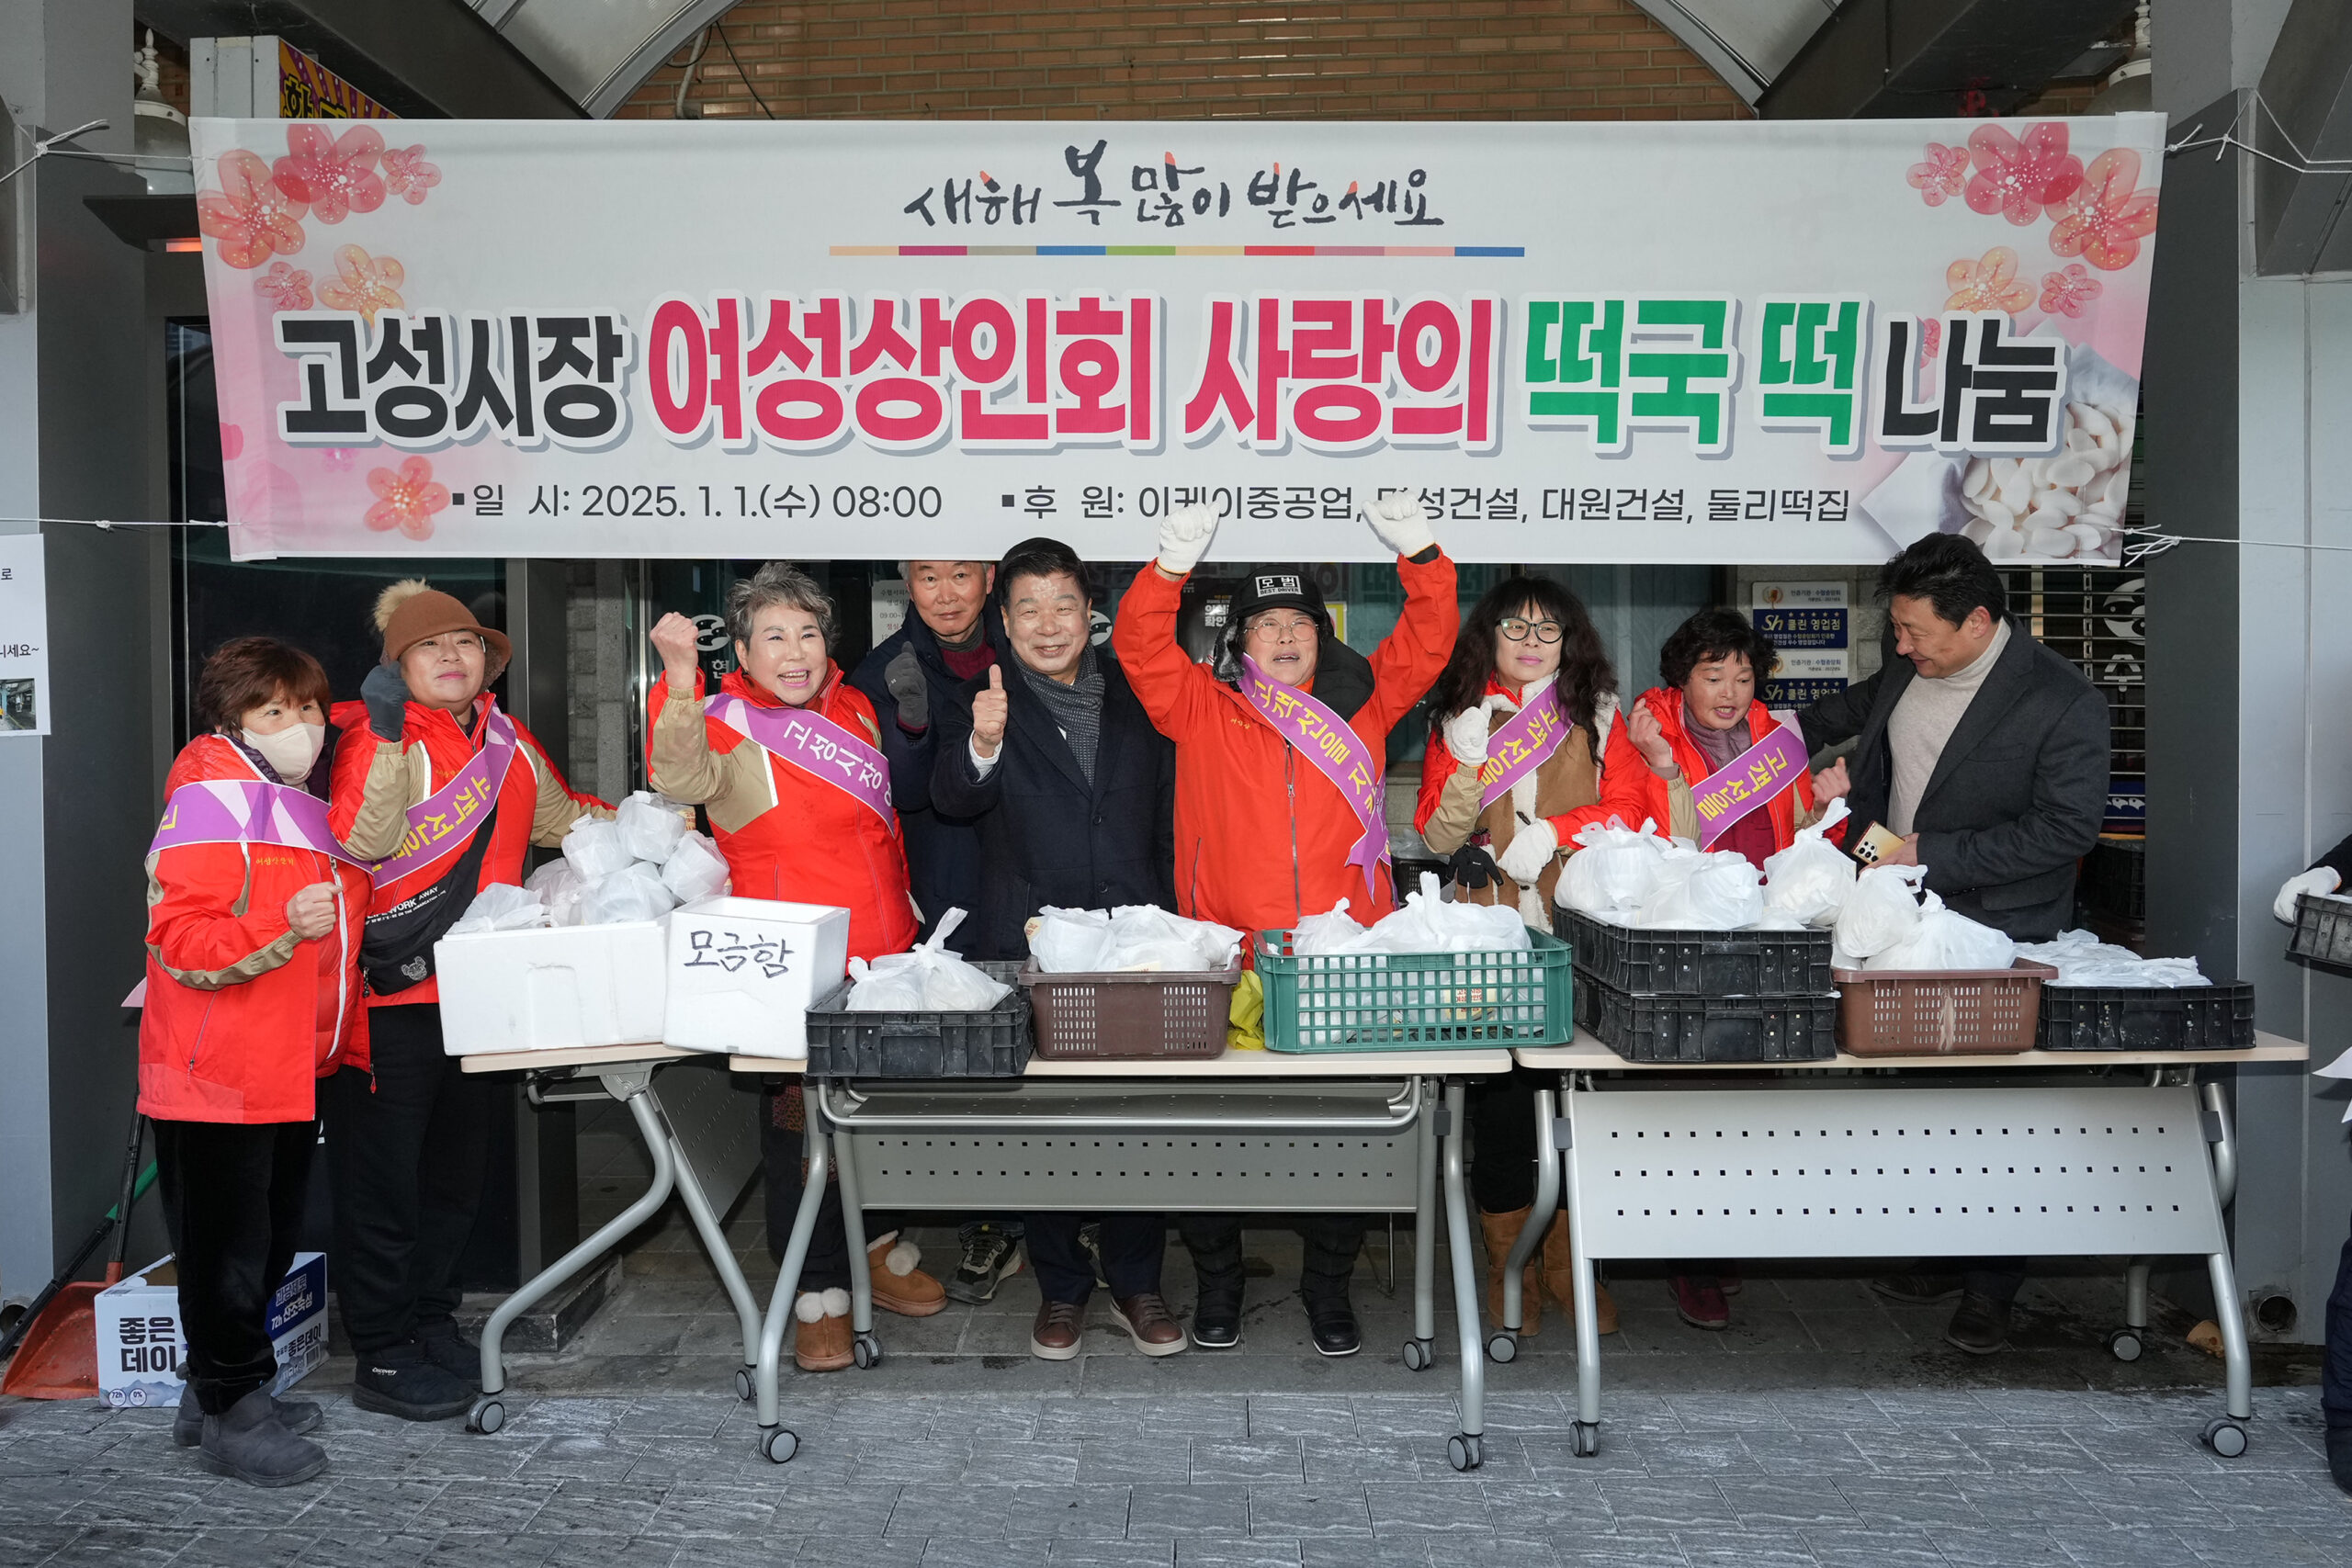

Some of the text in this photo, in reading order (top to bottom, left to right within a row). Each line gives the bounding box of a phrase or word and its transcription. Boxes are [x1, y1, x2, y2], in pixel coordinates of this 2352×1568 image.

[904, 140, 1445, 229] 새해 복 많이 받으세요
[281, 297, 2060, 446] 고성시장 여성상인회 사랑의 떡국 떡 나눔
[473, 484, 503, 516] 일
[528, 484, 570, 517] 시:
[832, 485, 943, 518] 08:00
[1023, 485, 1057, 519] 후
[1080, 486, 1124, 519] 원:
[1377, 487, 1528, 524] 성건설,
[1542, 488, 1692, 525] 대원건설,
[1707, 490, 1849, 522] 둘리떡집
[1761, 615, 1840, 631] Sh 클린 영업점
[1761, 684, 1784, 701] Sh
[1787, 688, 1807, 701] 클린
[1251, 679, 1351, 766] 고객선을
[783, 719, 883, 790] 고성시장
[1696, 746, 1789, 822] 고객선을
[418, 886, 438, 901] AWAY
[683, 930, 796, 979] 모금함
[119, 1316, 175, 1345] 좋은
[288, 1323, 322, 1358] 좋은데이
[120, 1346, 176, 1373] 데이
